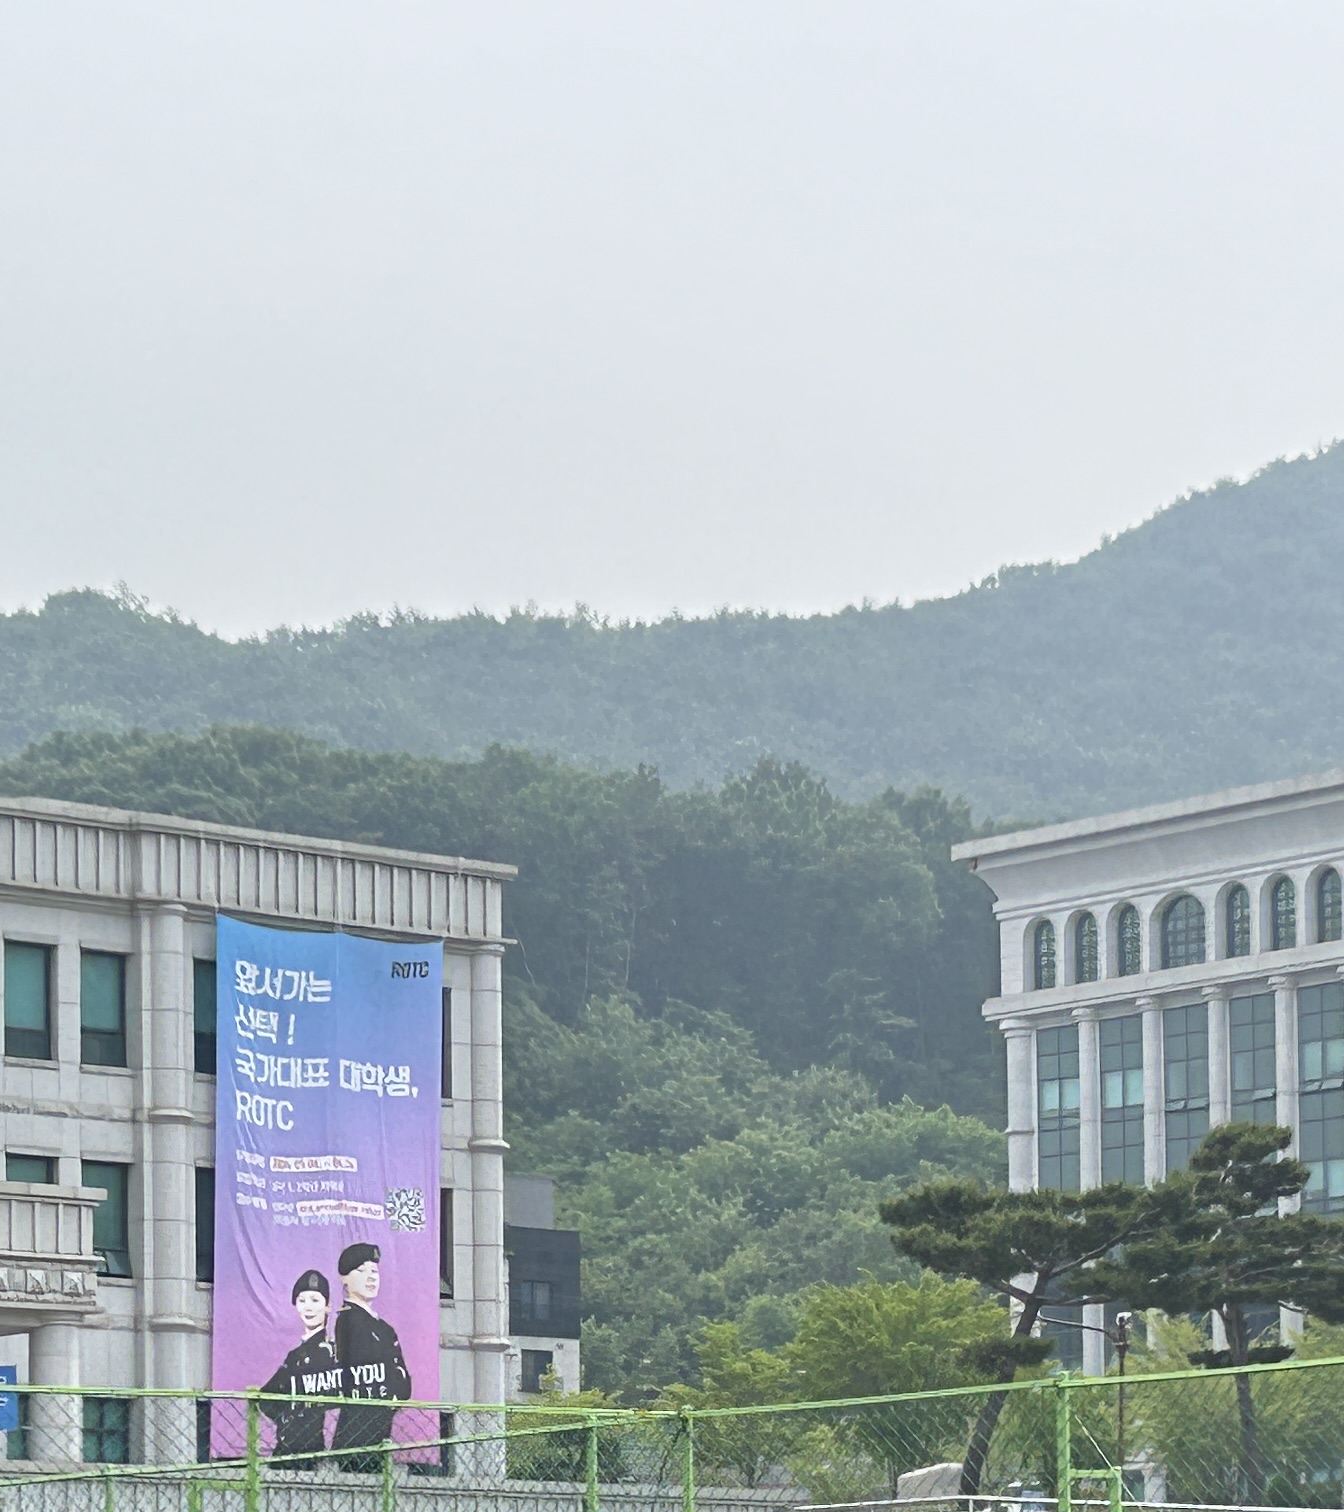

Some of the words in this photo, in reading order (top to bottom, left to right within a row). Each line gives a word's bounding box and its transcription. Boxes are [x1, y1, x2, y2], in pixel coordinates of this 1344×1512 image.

[235, 960, 332, 1002] 앞서가는
[391, 961, 429, 978] ROTC
[235, 1046, 330, 1088] 국가대표
[236, 1089, 294, 1131] ROTC
[302, 1368, 343, 1394] WANT
[350, 1362, 385, 1386] YOU
